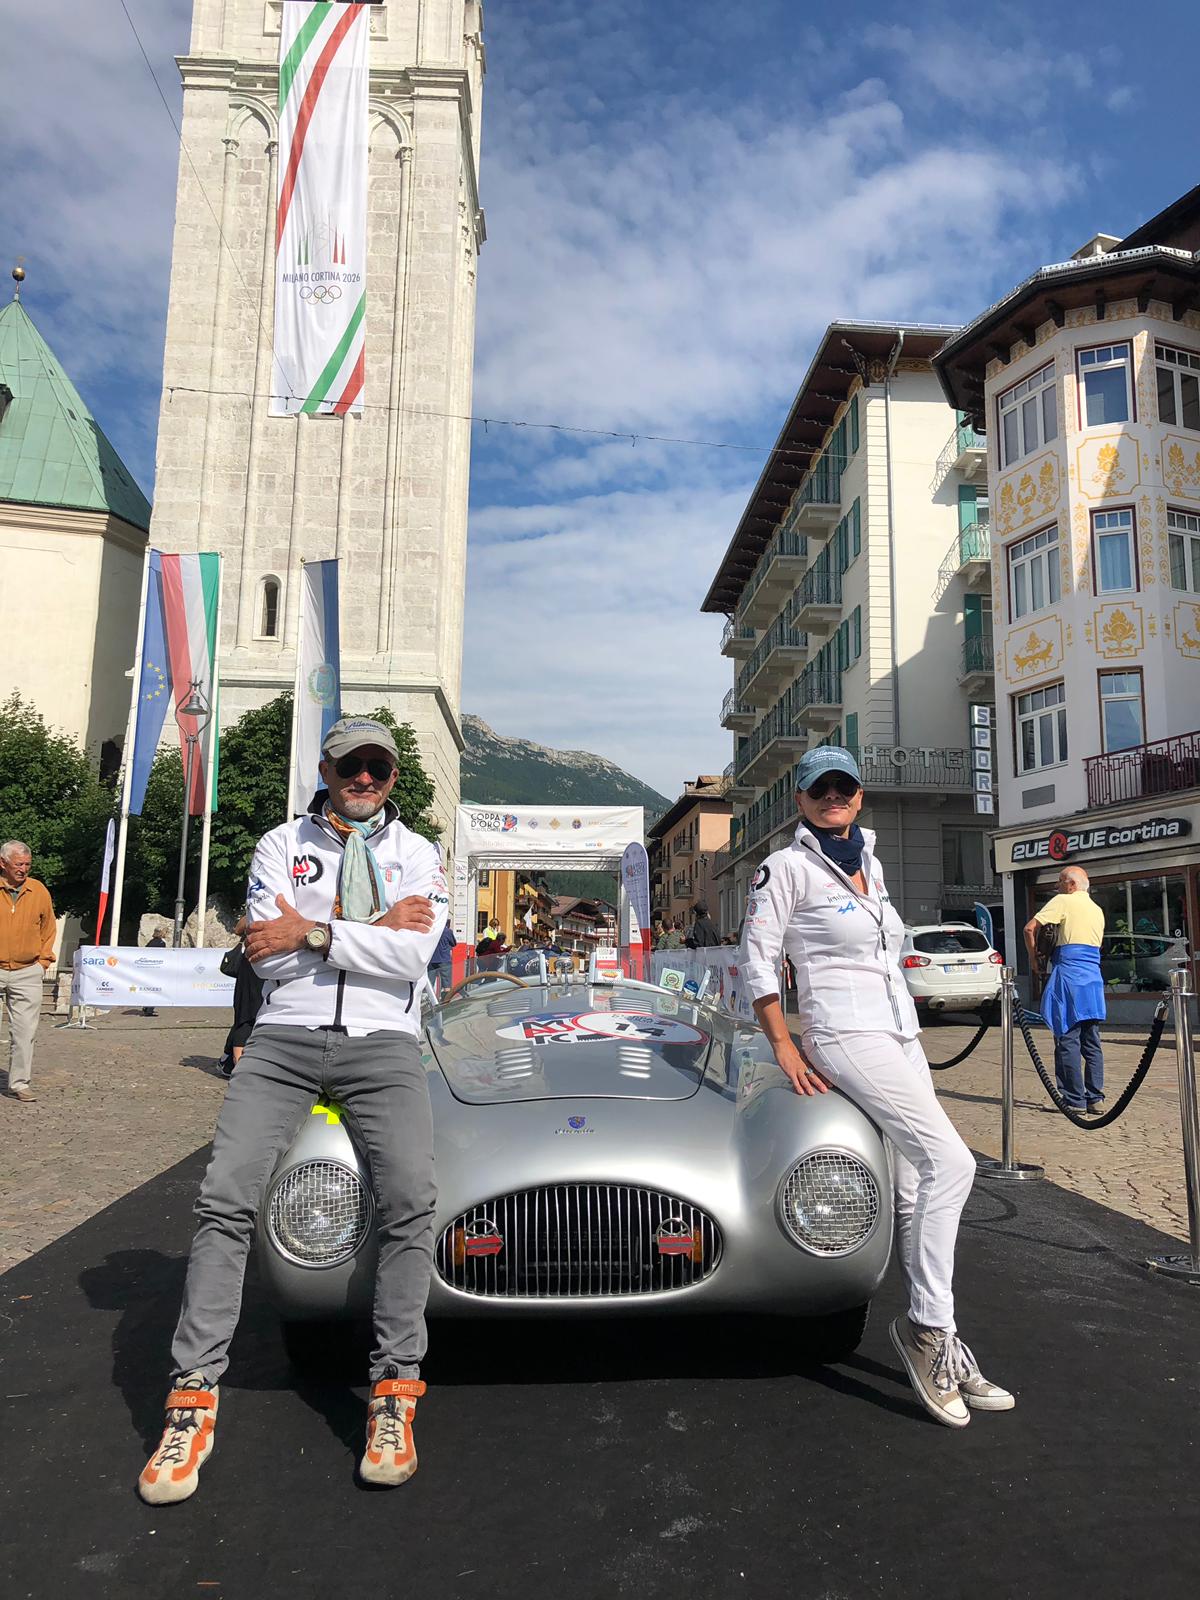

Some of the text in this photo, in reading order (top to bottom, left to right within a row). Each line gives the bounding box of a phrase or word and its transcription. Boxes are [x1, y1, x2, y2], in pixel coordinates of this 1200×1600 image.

[282, 271, 361, 283] MILANO CORTINA 2026
[860, 746, 963, 769] HOTE
[977, 708, 991, 812] SPORT
[471, 813, 500, 821] COPPA
[471, 820, 500, 828] D'ORO
[1108, 822, 1180, 845] cortina
[82, 957, 105, 966] sara
[615, 1022, 667, 1037] 14
